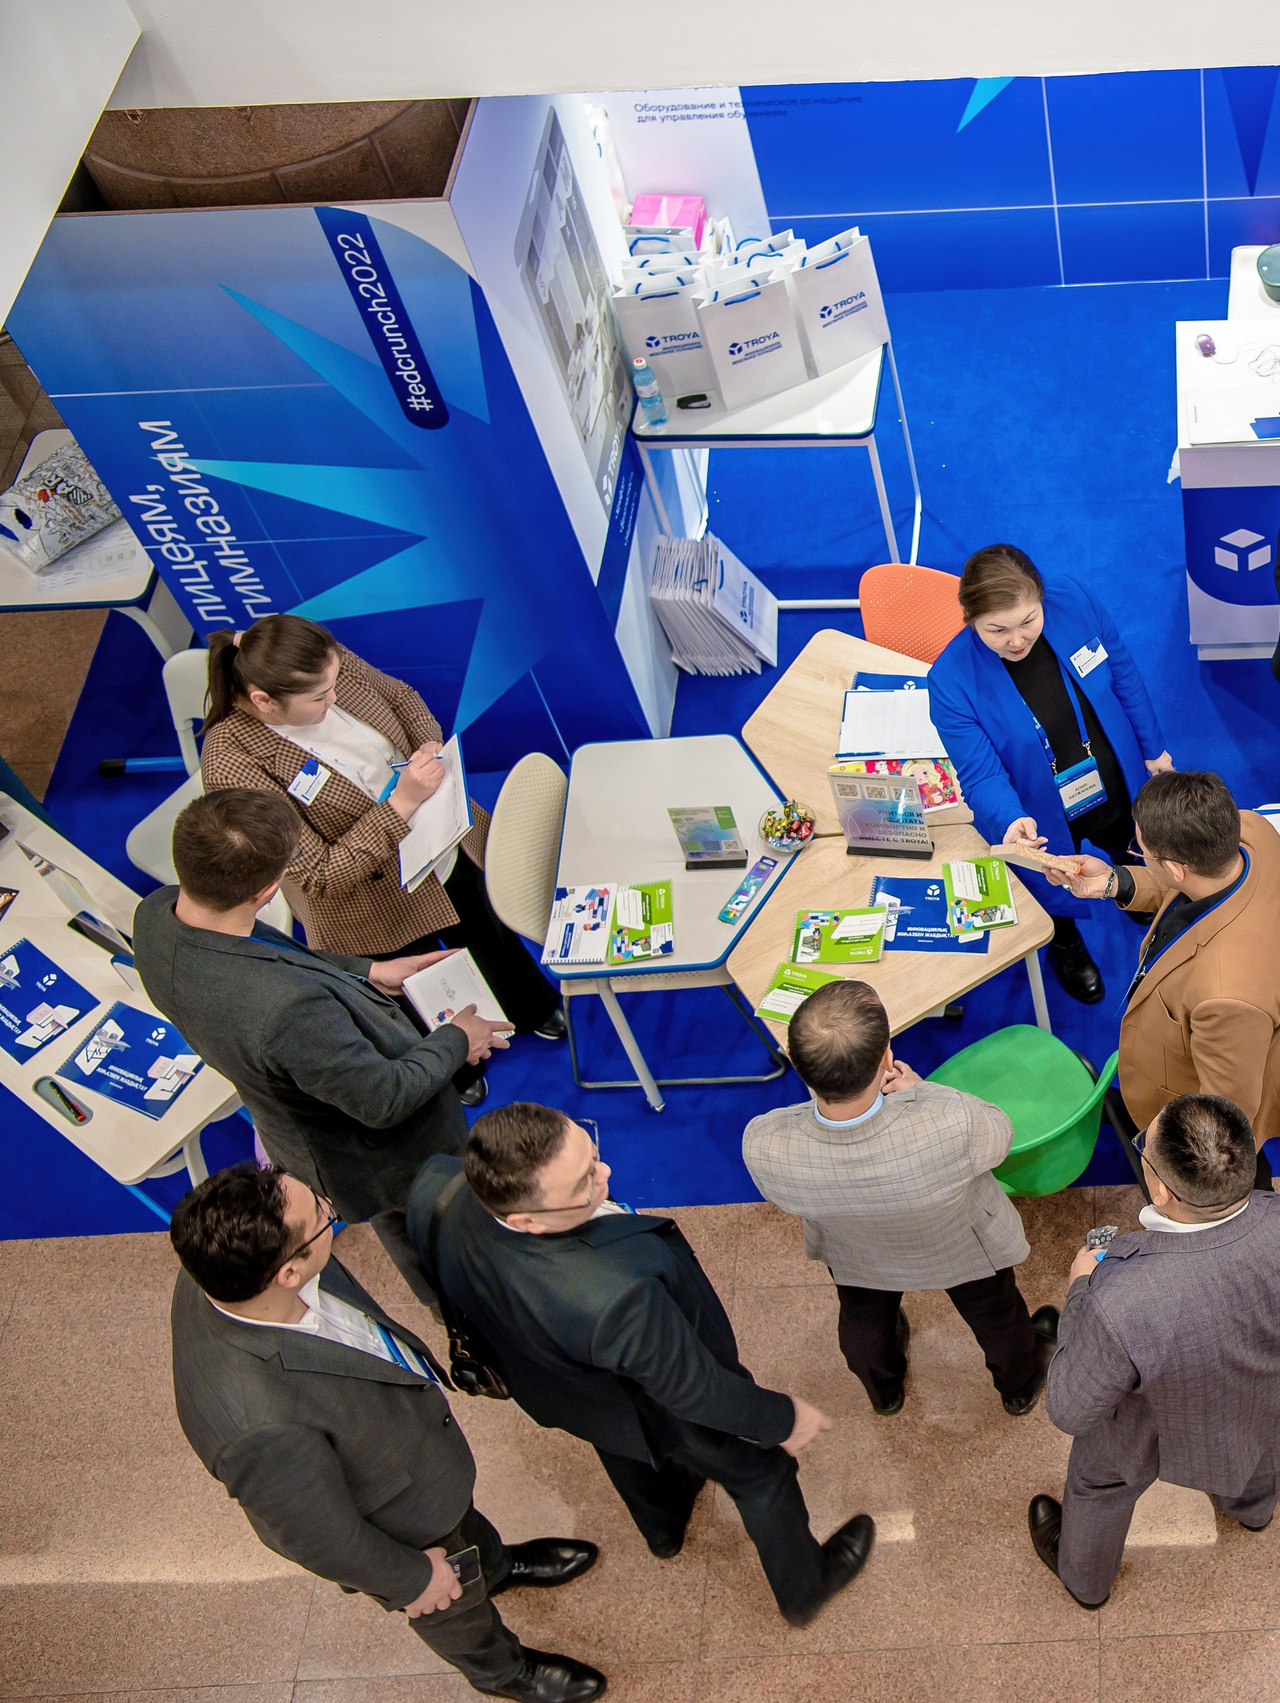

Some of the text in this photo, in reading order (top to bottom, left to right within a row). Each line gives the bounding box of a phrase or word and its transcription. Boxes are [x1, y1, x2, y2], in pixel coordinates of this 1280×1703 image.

[634, 100, 717, 114] Оборудование
[719, 102, 727, 110] и
[637, 114, 657, 123] для
[660, 111, 725, 124] управления
[833, 291, 867, 311] TROYA
[337, 233, 434, 411] #edcrunch2022
[661, 331, 700, 344] TROYA
[743, 331, 780, 349] TROYA
[877, 809, 915, 818] УЧИТСЯ
[791, 971, 807, 979] TROYA
